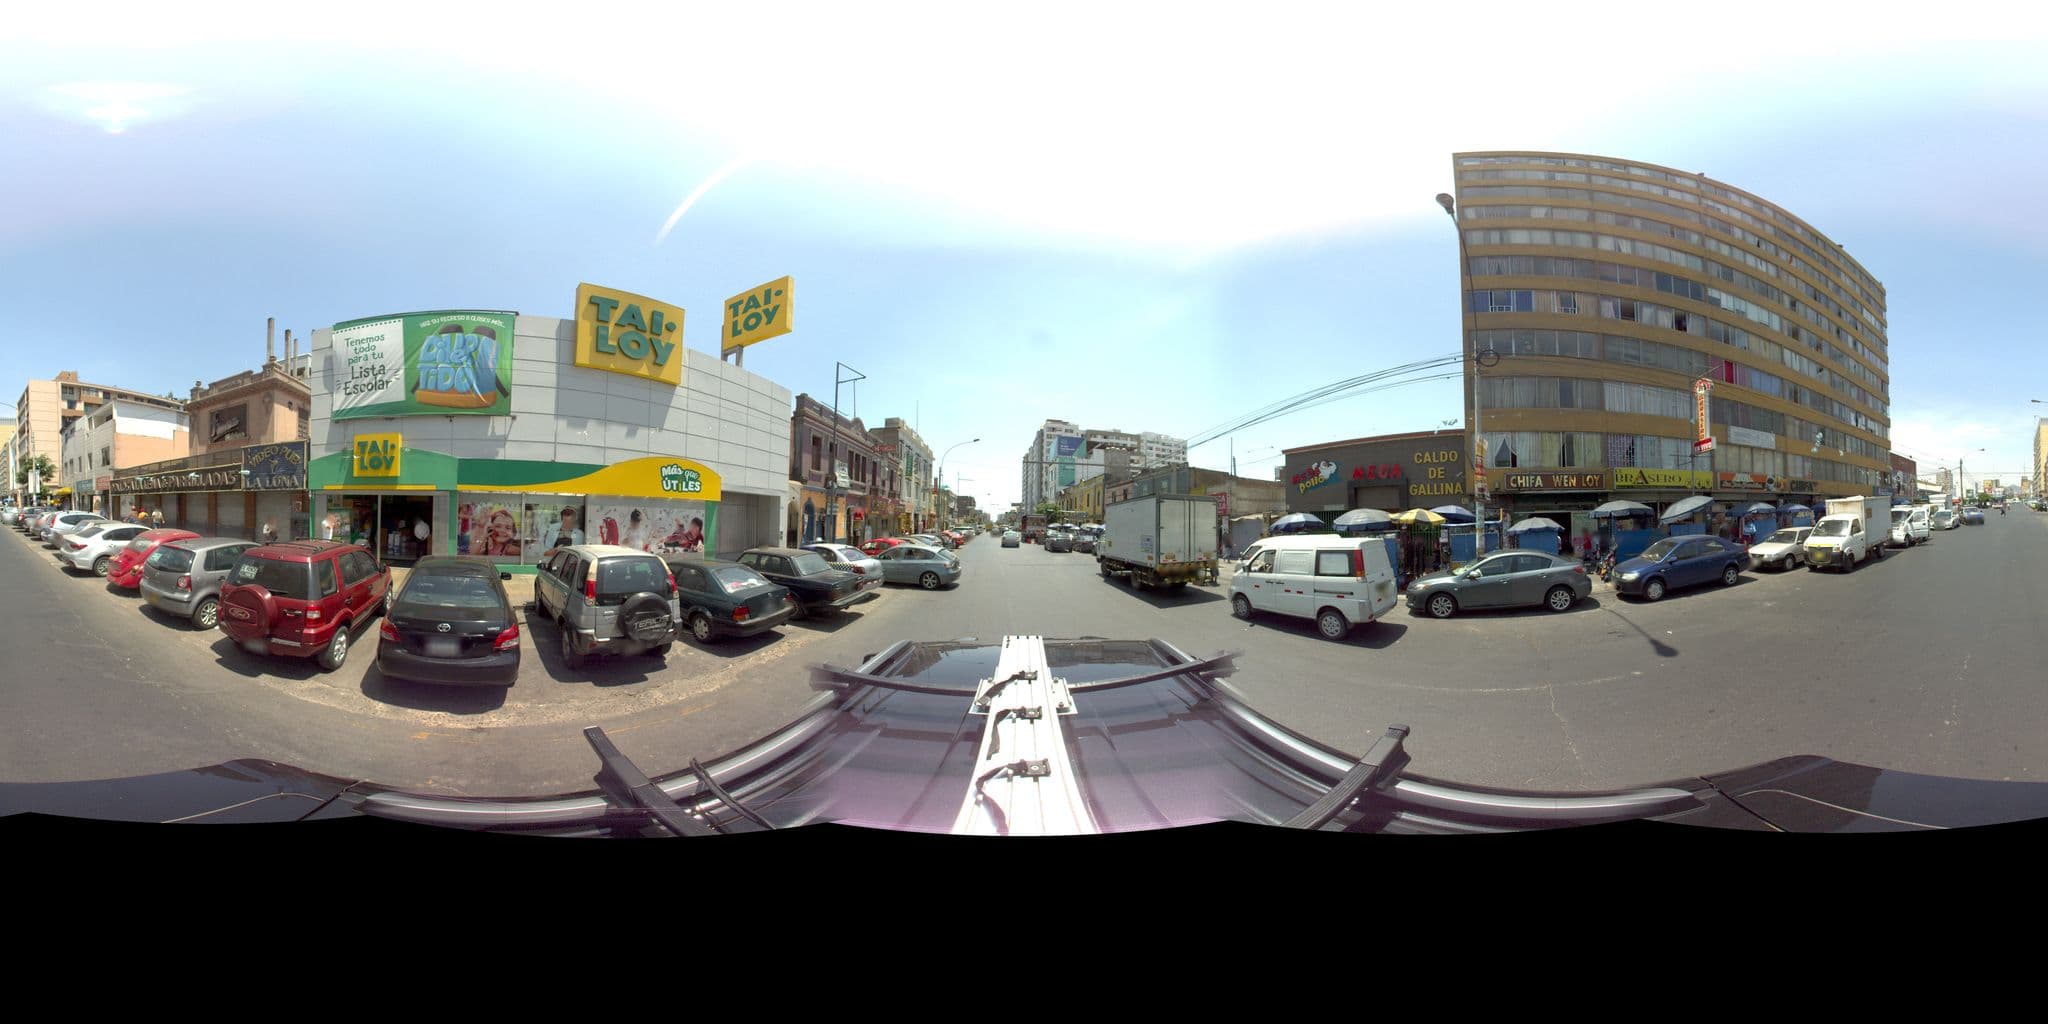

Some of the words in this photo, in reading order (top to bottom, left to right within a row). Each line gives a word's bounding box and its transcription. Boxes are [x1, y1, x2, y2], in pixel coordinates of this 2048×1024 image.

[731, 304, 780, 337] LOY
[344, 334, 385, 348] Tenemos
[595, 325, 675, 366] LOY
[354, 344, 376, 355] todo
[348, 352, 368, 366] para
[372, 351, 384, 360] tu
[351, 364, 386, 380] Lista
[343, 377, 392, 396] Escolar
[250, 446, 278, 467] VIDEO
[360, 455, 395, 470] LOY
[1414, 450, 1458, 464] CALDO
[661, 465, 683, 477] Más
[1352, 464, 1402, 480] MEGA
[1428, 467, 1445, 479] DE
[246, 477, 261, 489] LA
[1509, 475, 1543, 488] CHIFA
[1552, 475, 1576, 488] WEN
[1581, 475, 1600, 487] LOY
[1409, 482, 1464, 496] GALLINA
